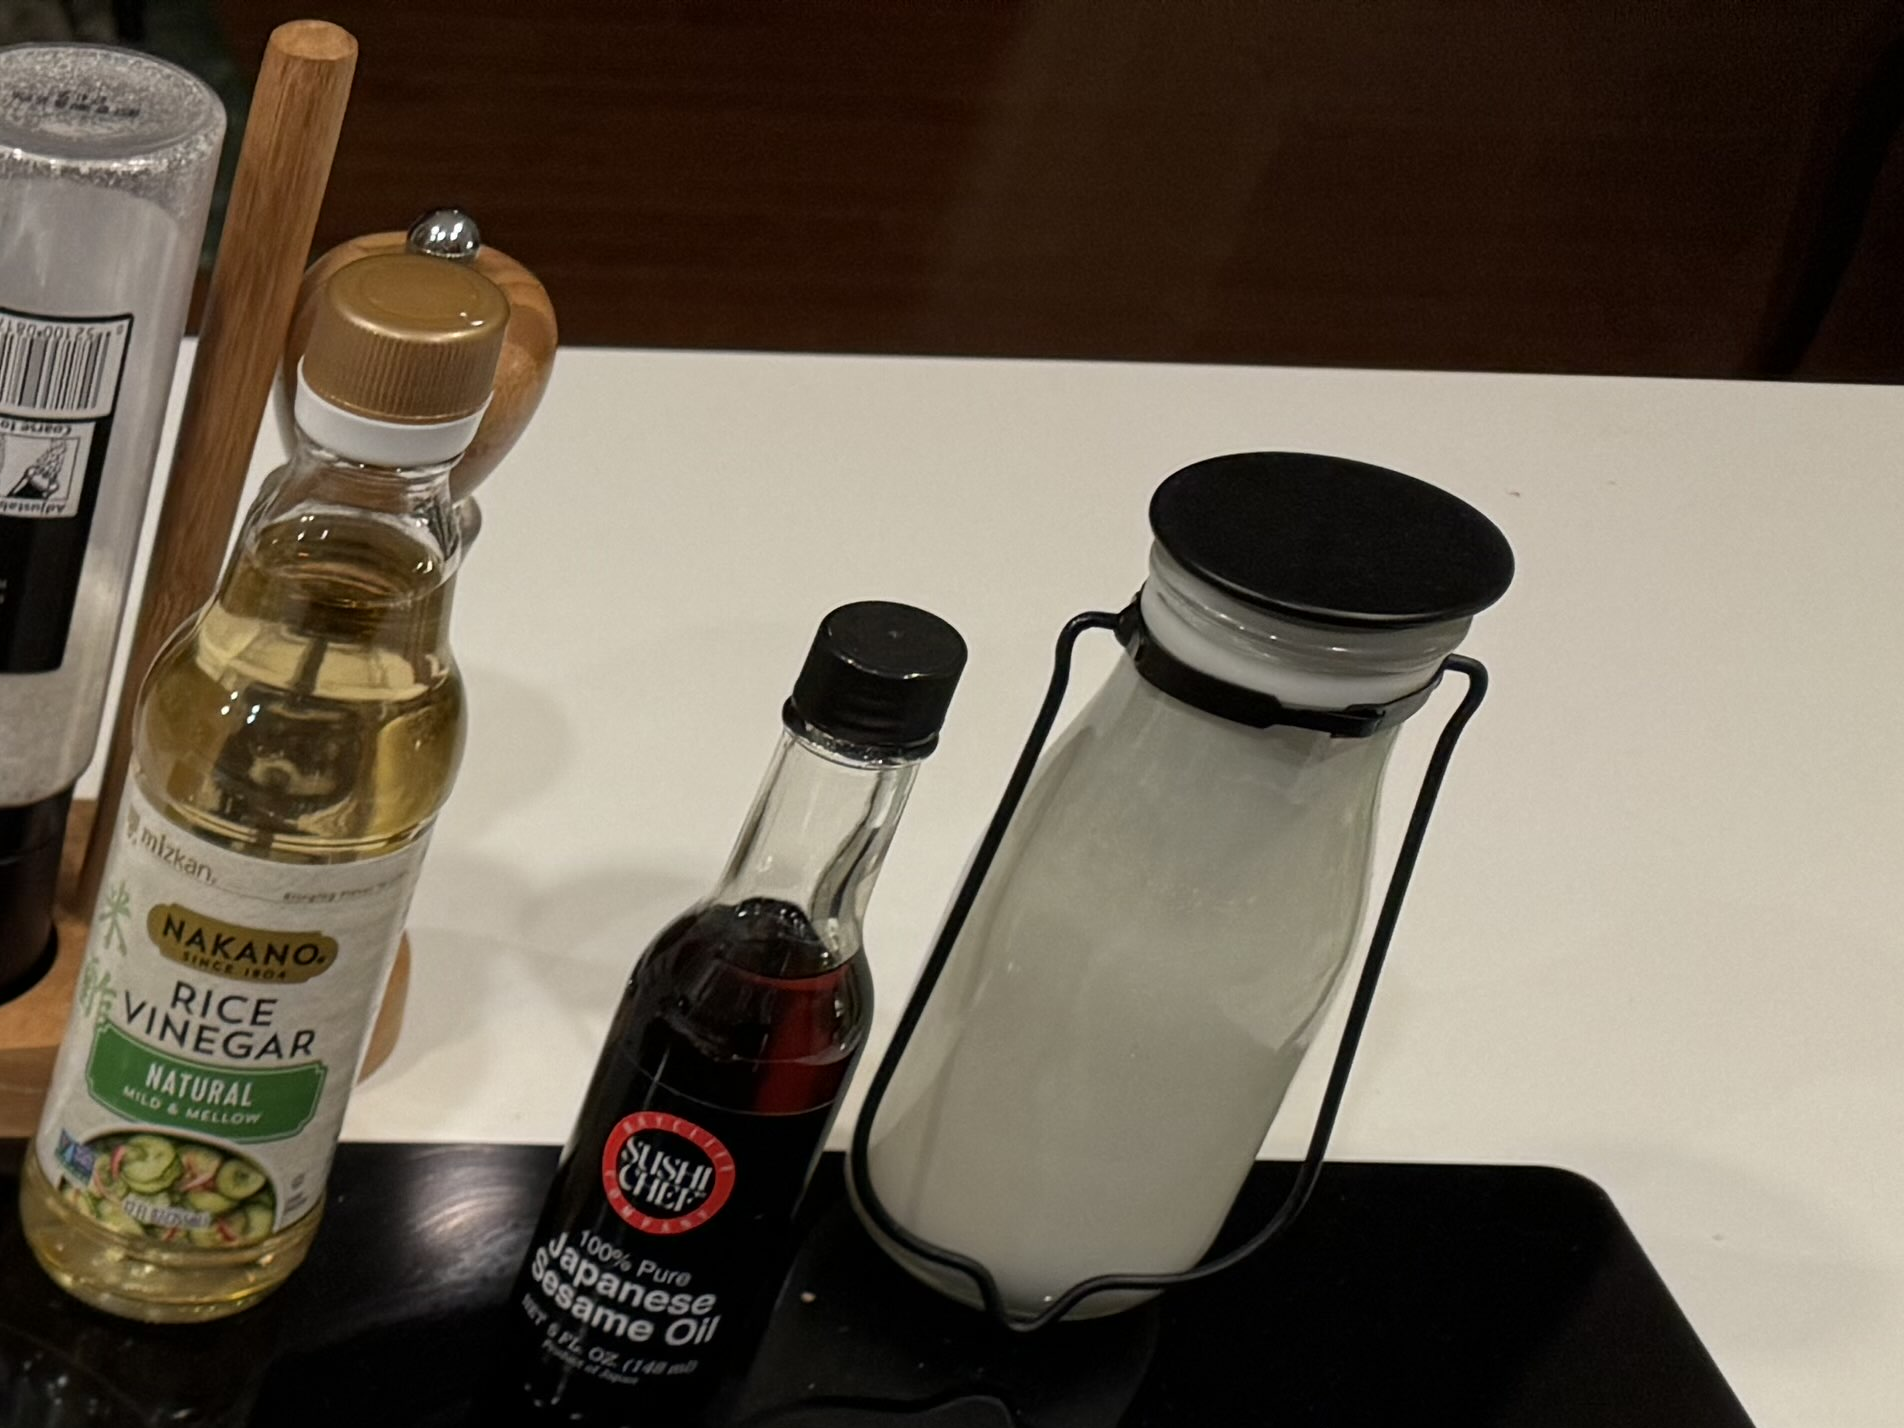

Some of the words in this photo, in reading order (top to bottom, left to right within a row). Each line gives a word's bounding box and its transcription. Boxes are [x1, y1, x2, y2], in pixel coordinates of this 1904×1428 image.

[0, 418, 17, 434] to
[19, 421, 73, 438] Coarse
[162, 912, 320, 967] NAKANO
[182, 950, 234, 975] SINCE
[123, 989, 317, 1061] VINEGAR
[170, 979, 278, 1027] RICE
[122, 1085, 162, 1110] MILD
[167, 1102, 179, 1116] &
[185, 1106, 263, 1125] MELLOW
[145, 1061, 254, 1108] NATURAL
[618, 1163, 707, 1213] CHEF
[620, 1135, 714, 1192] SUSHI
[547, 1231, 717, 1316] Japanese
[579, 1229, 632, 1272] 100%
[636, 1258, 692, 1287] Pure
[531, 1246, 654, 1342] Sesame
[664, 1314, 722, 1346] Oil
